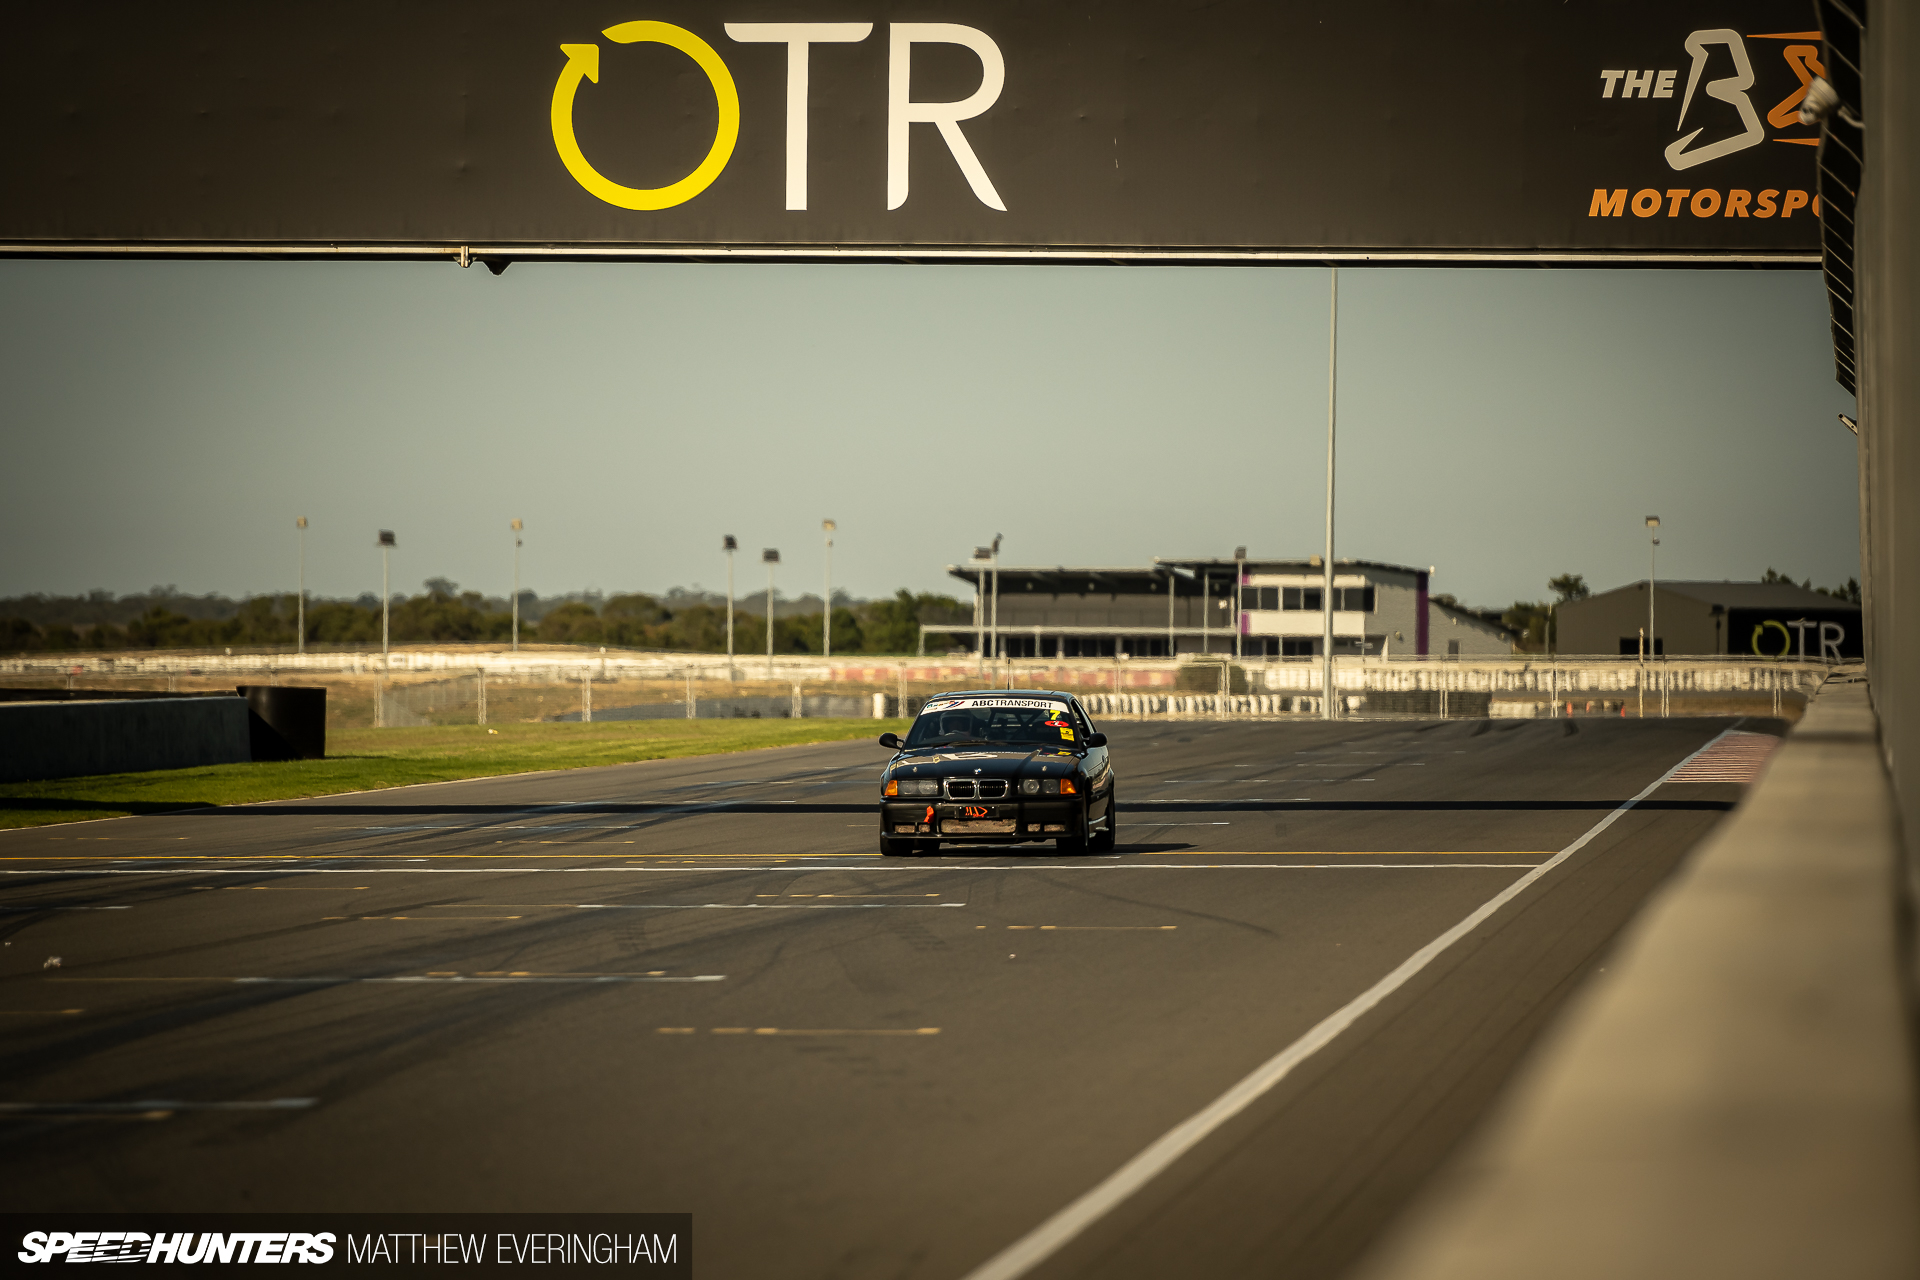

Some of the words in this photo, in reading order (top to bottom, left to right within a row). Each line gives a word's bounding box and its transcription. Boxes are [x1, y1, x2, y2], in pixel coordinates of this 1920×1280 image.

[1600, 69, 1678, 98] THE
[551, 20, 1007, 211] OTR
[1588, 188, 1821, 219] MOTORSP
[1751, 619, 1845, 665] OTR
[1049, 709, 1061, 721] 7
